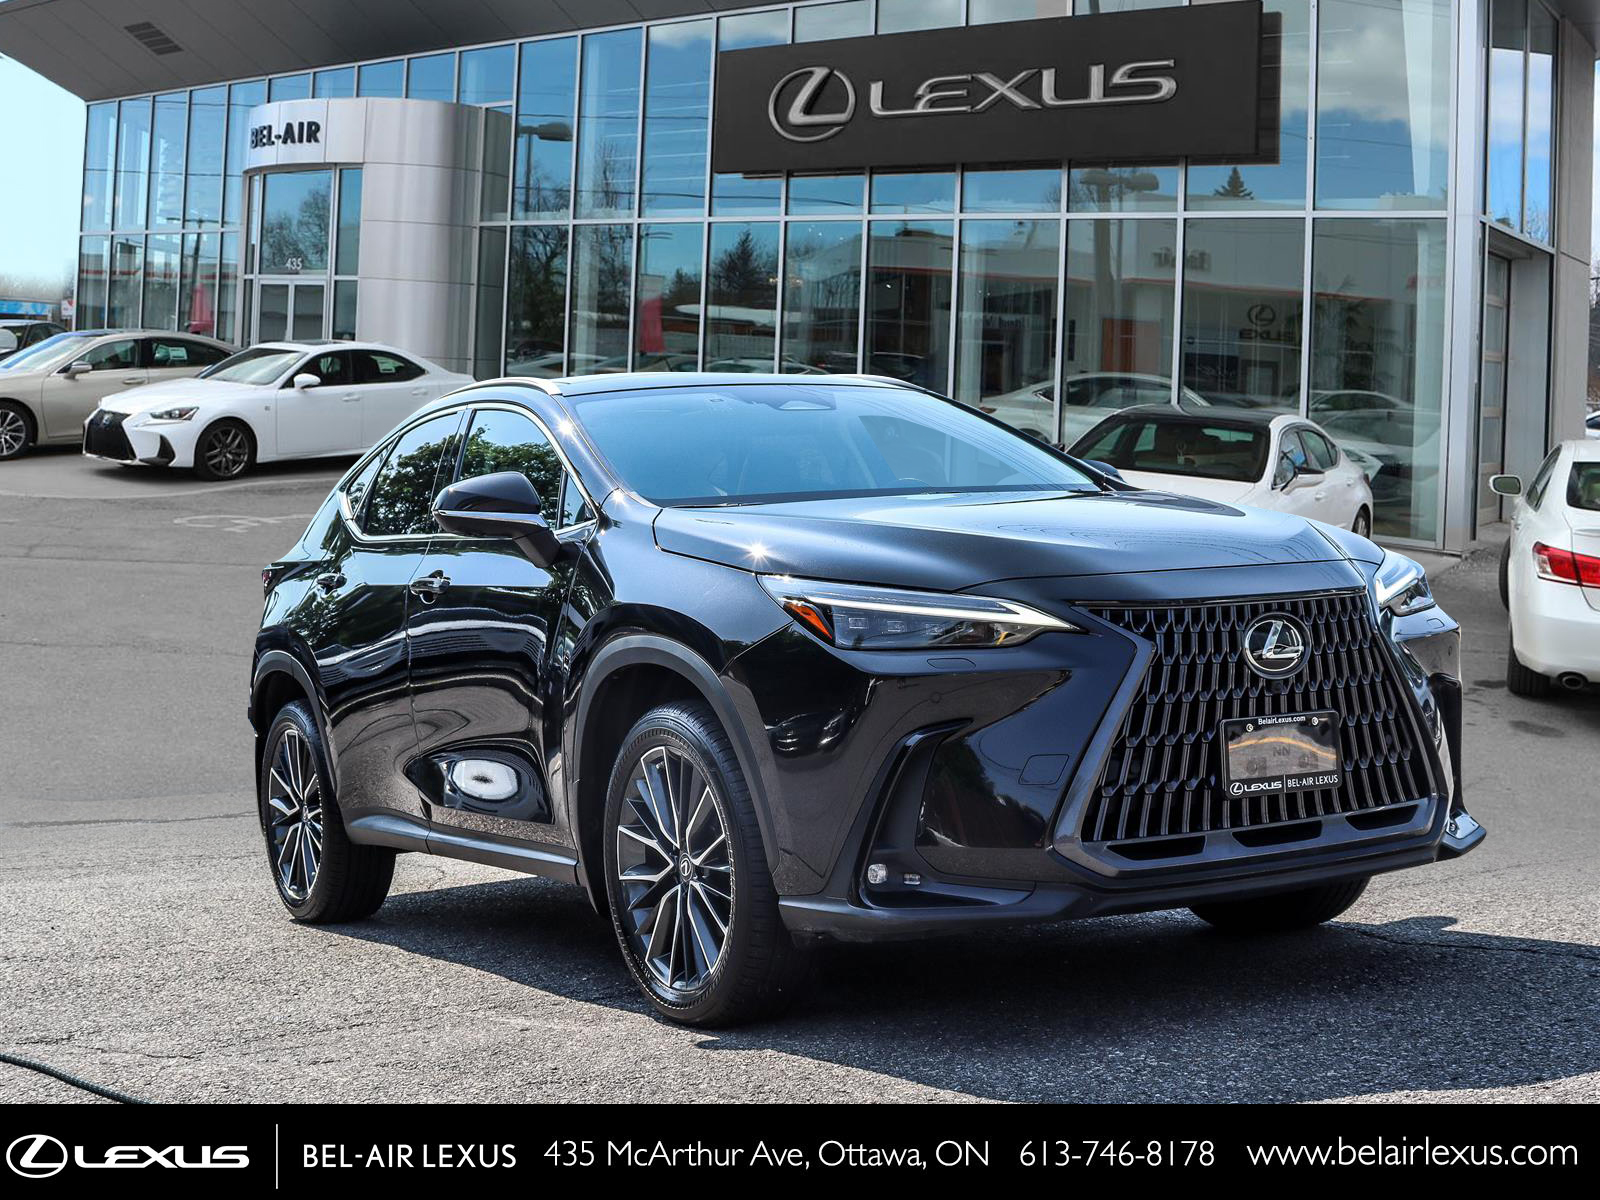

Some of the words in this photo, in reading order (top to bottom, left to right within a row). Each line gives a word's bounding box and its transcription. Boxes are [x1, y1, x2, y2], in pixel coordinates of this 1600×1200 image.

[869, 58, 1178, 118] LEXUS
[250, 120, 321, 149] BEL-AIR
[285, 257, 303, 270] 435
[1244, 781, 1282, 792] LEXUS
[1287, 777, 1314, 788] BEL-AIR
[1315, 774, 1339, 785] LEXUS
